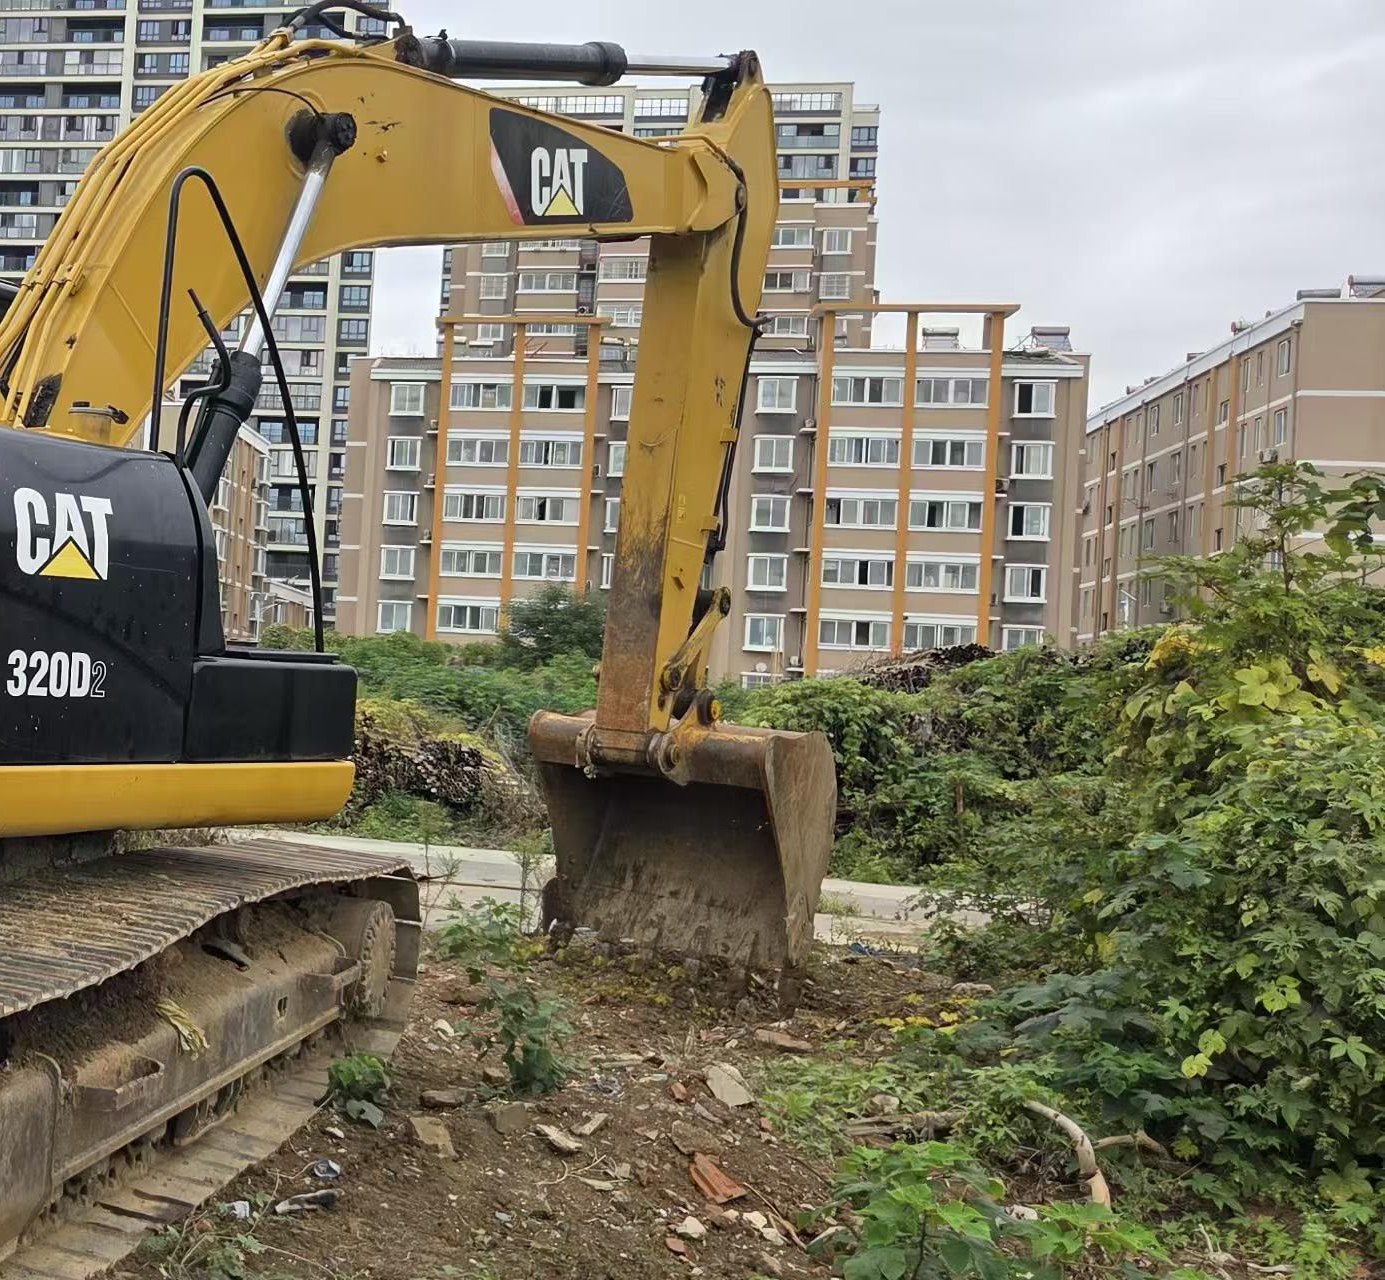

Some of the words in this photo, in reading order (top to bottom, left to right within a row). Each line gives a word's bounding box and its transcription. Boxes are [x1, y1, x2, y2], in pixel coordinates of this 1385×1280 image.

[531, 147, 588, 216] CAT
[14, 487, 113, 580] CAT
[6, 650, 107, 698] 320D2
